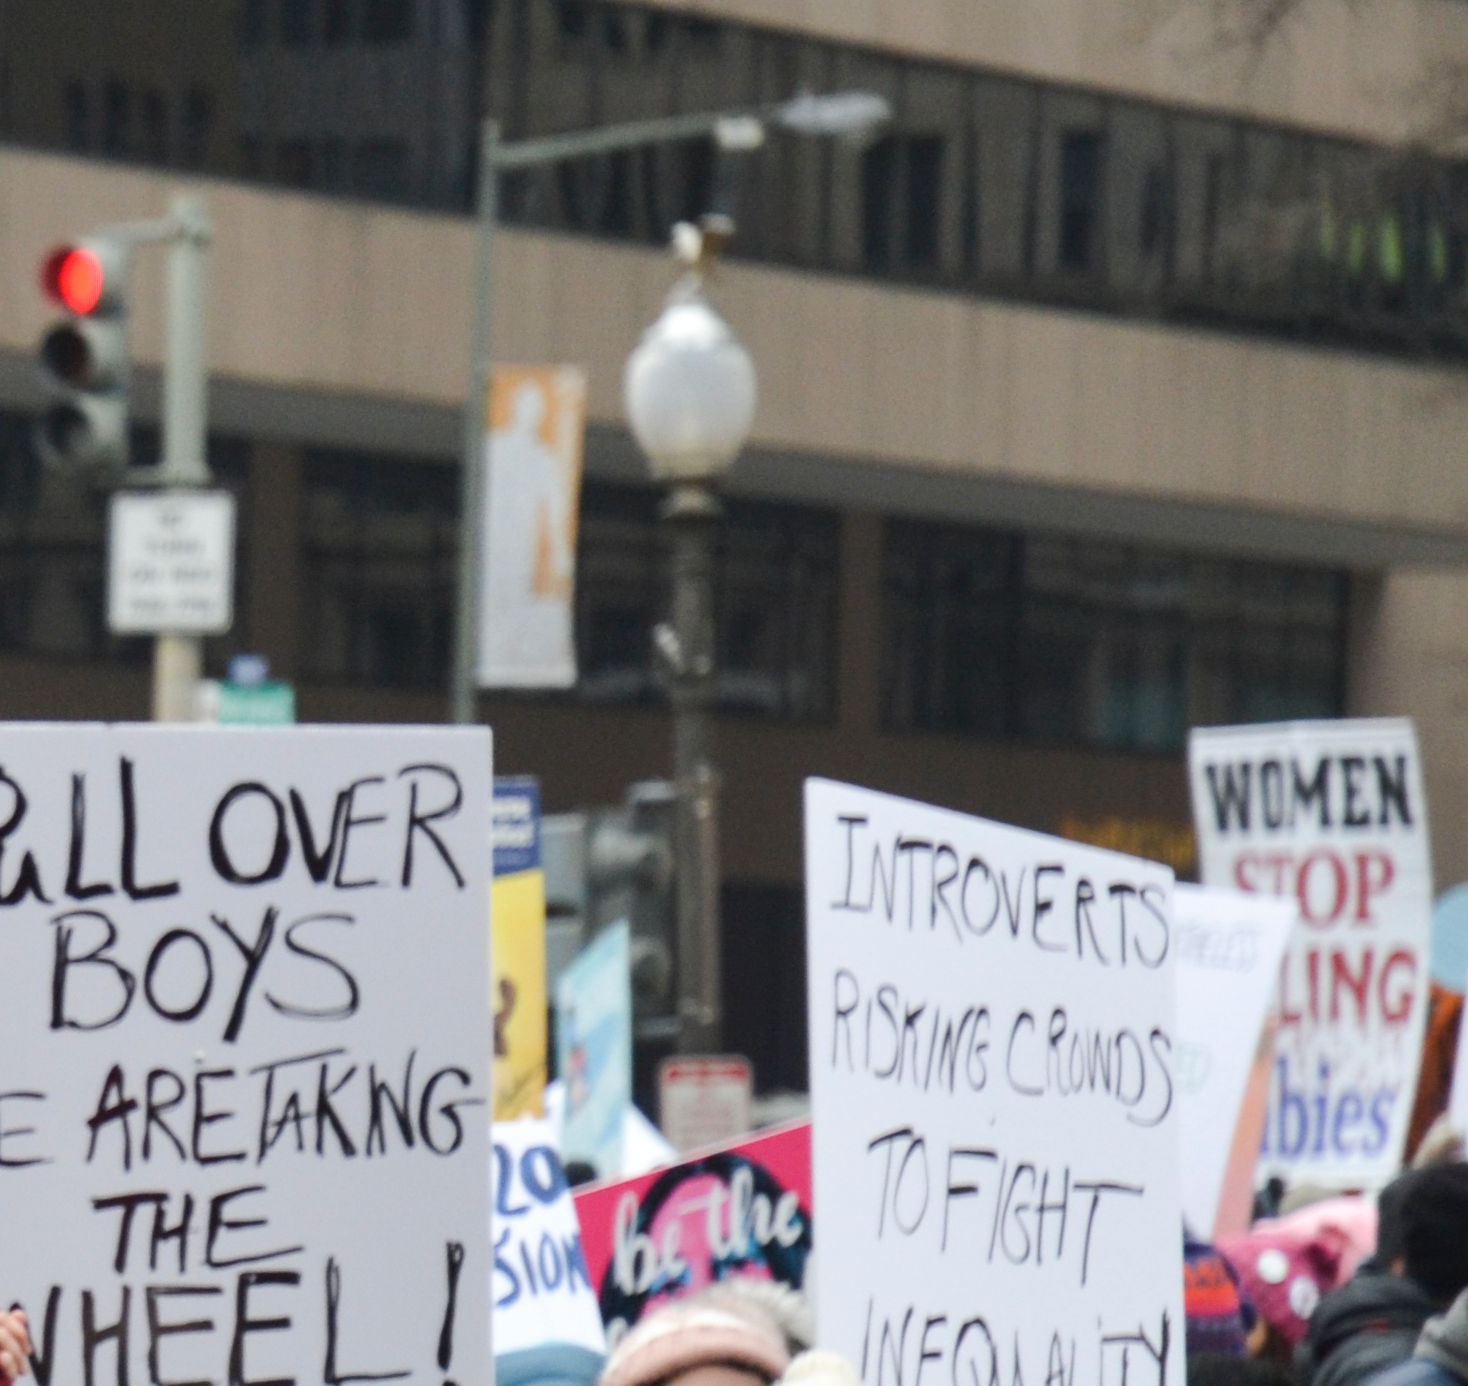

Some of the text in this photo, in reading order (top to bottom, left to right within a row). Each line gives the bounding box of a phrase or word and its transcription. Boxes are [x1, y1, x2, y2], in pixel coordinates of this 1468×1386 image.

[209, 764, 465, 890] OVER
[1206, 754, 1413, 834] WOMEN
[830, 815, 1169, 970] INTROVERTS
[1235, 851, 1396, 931] STOP
[50, 907, 360, 1043] BOYS
[1279, 950, 1418, 1027] LING
[831, 968, 989, 1093] RISKING
[1005, 1005, 1174, 1126] CROWDS
[85, 1062, 247, 1171] ARE
[1261, 1057, 1394, 1163] bies
[91, 1185, 304, 1275] THE
[615, 1168, 802, 1293] be the
[868, 1126, 1144, 1286] TO FIGHT
